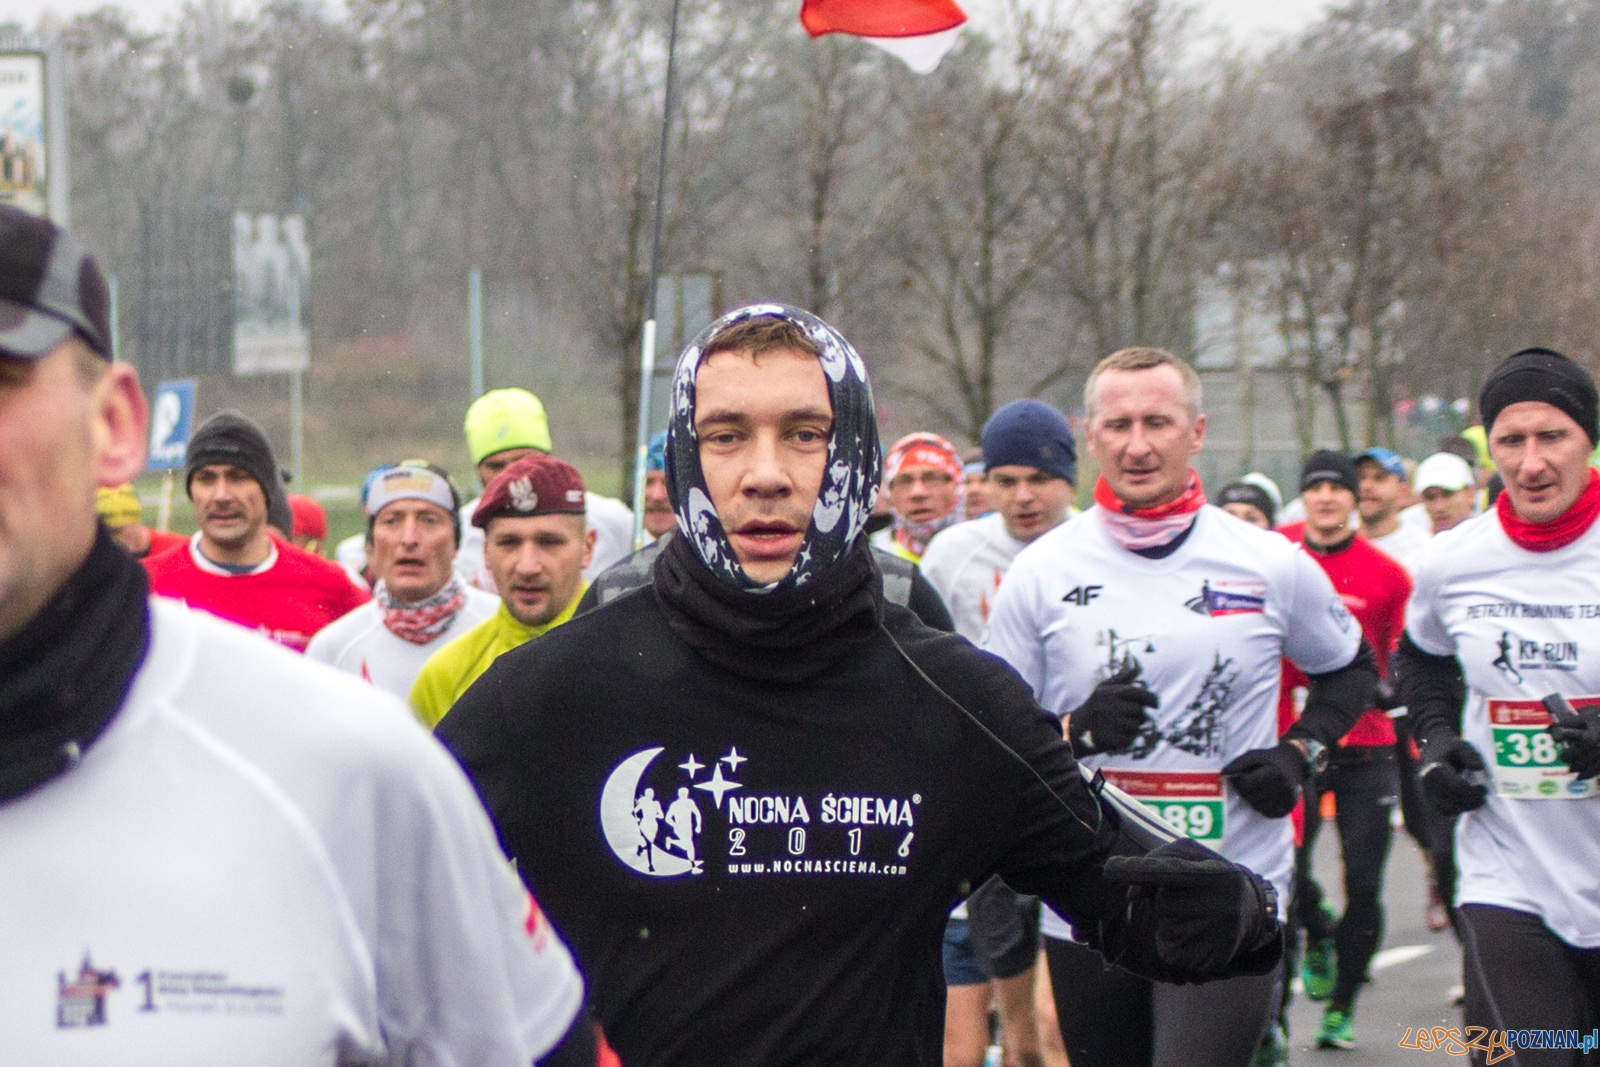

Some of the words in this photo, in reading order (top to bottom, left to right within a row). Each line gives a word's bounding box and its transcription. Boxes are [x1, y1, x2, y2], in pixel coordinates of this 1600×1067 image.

[1062, 585, 1104, 606] 4F
[1521, 604, 1575, 619] RUNNING
[1544, 642, 1577, 661] RUN
[728, 796, 809, 824] NOCNA
[728, 860, 907, 875] www.NOCNASCIEMA.com
